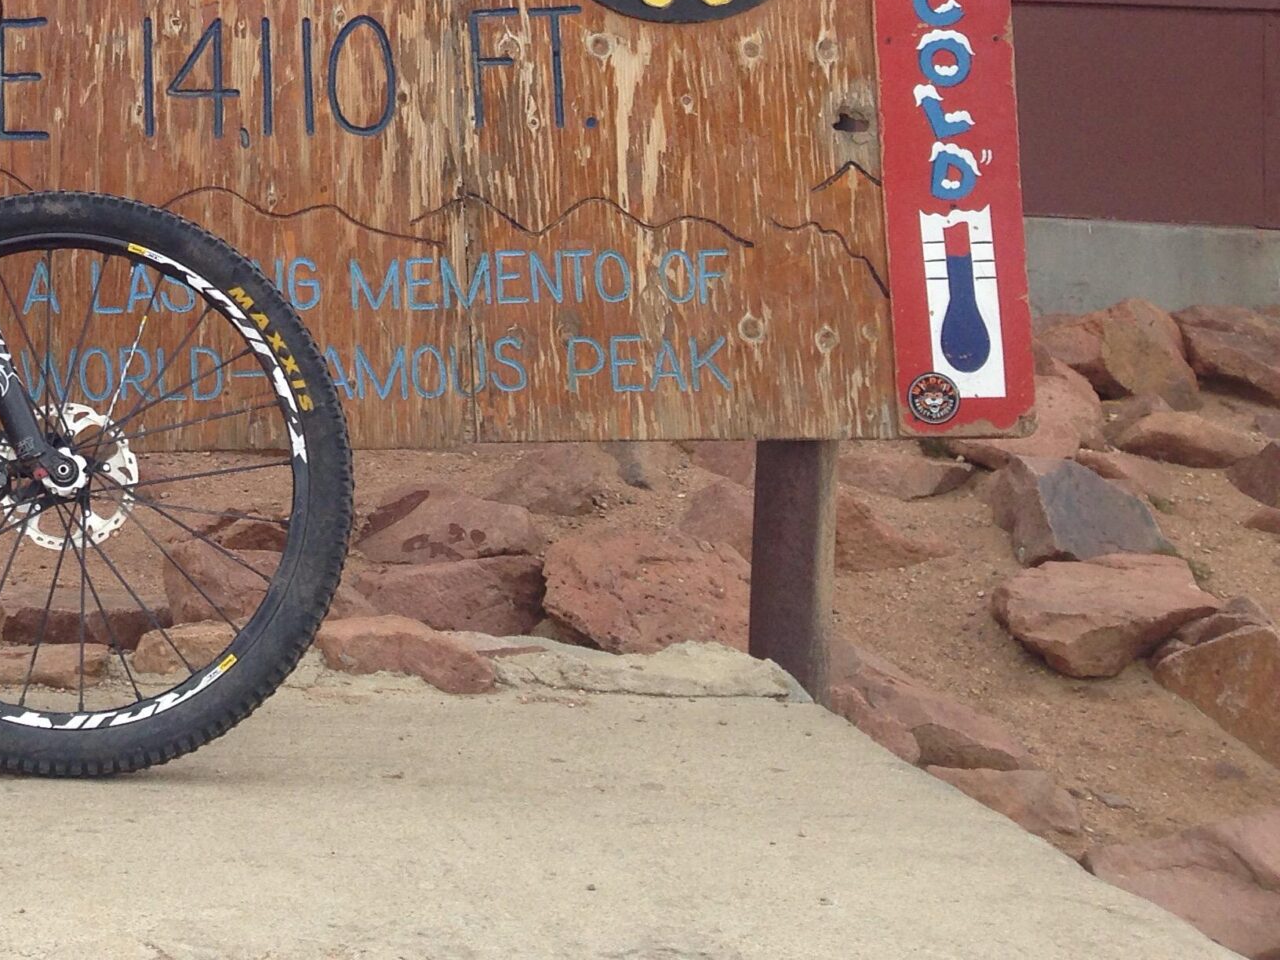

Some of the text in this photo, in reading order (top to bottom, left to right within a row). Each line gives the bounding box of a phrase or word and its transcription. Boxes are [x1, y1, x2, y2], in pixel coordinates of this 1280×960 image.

[470, 5, 597, 130] FT.
[23, 261, 60, 315] A
[349, 248, 632, 311] MEMENTO
[659, 248, 729, 305] OF
[228, 287, 315, 412] MAXXIS
[567, 334, 732, 393] PEAK
